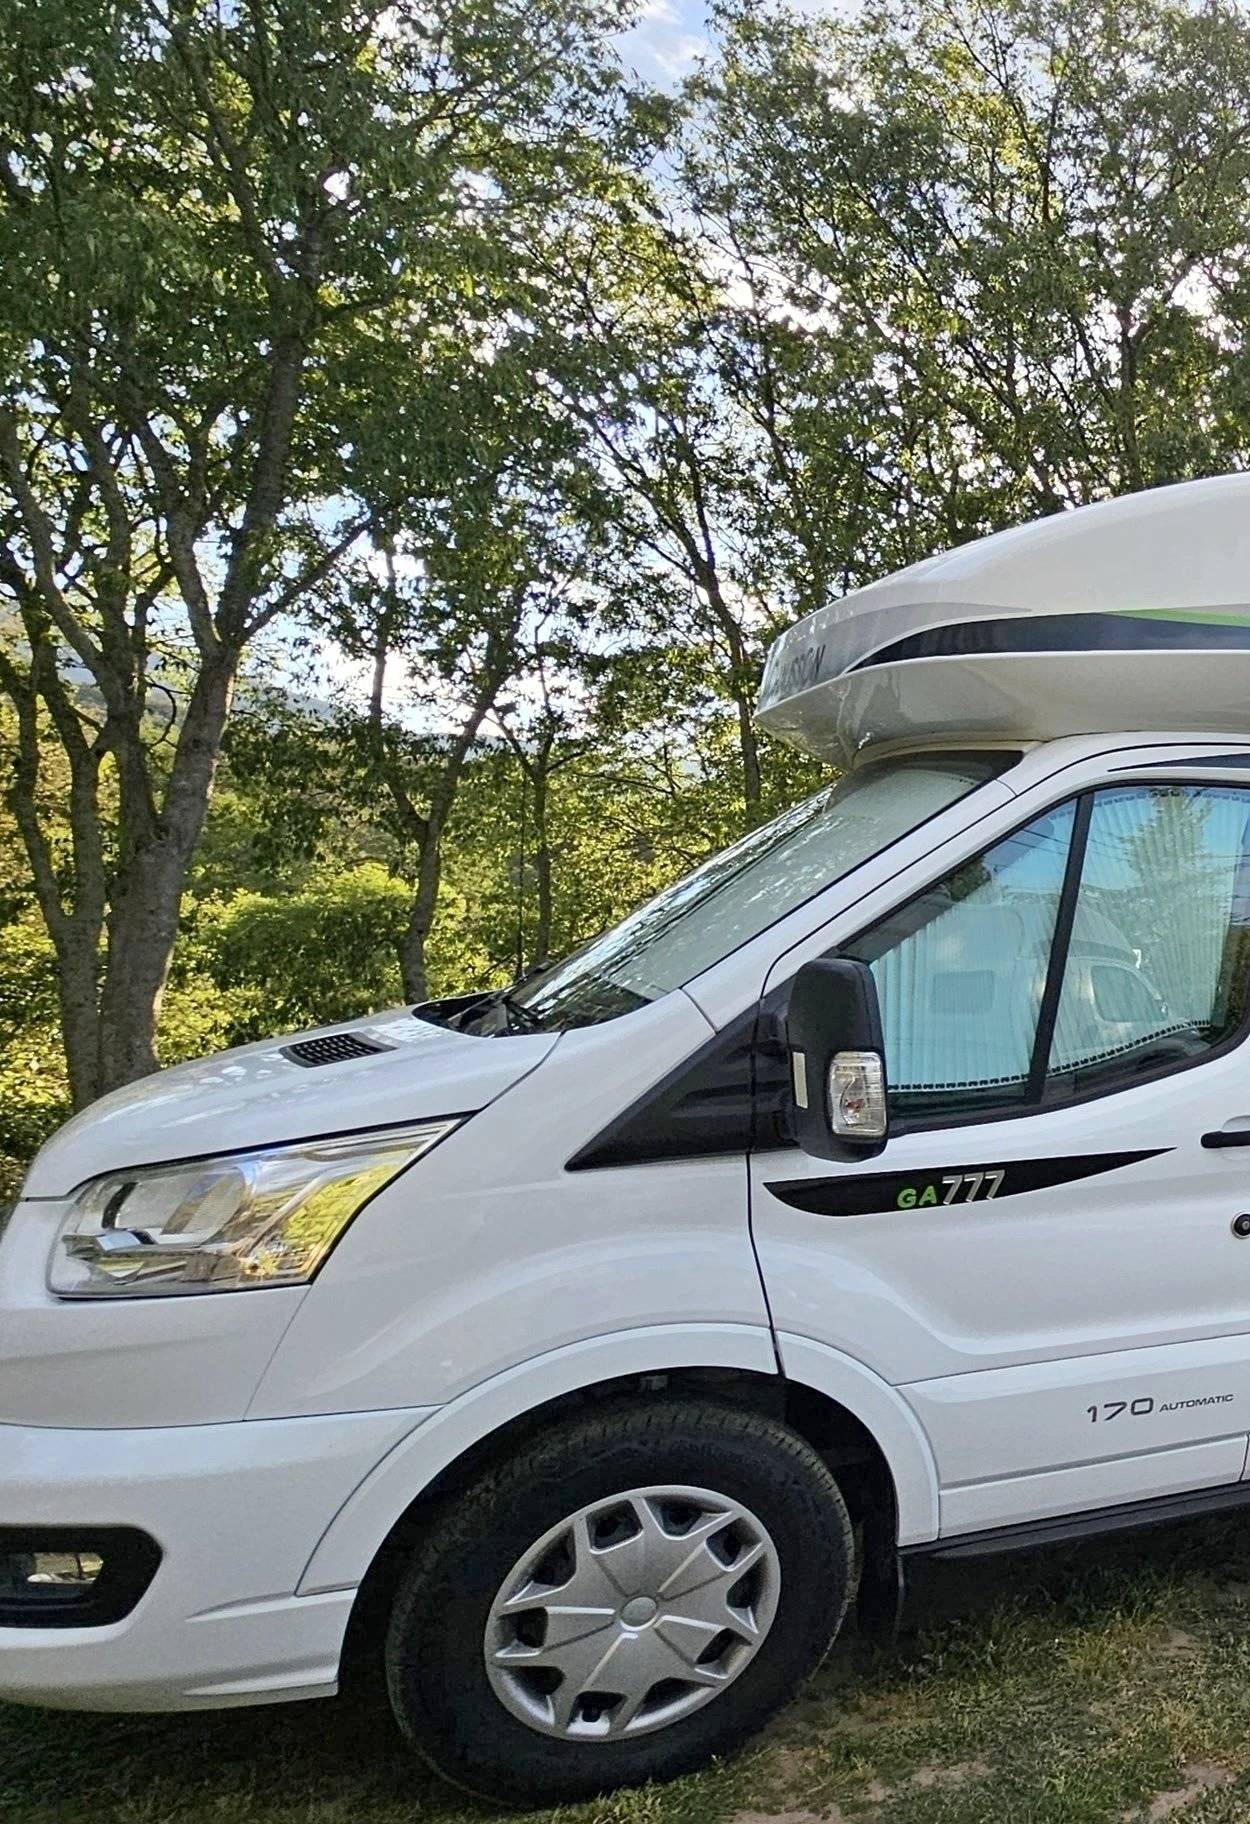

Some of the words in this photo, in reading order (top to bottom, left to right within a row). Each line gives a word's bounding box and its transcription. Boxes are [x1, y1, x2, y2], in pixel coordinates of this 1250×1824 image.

[897, 1170, 1006, 1209] GA777
[1087, 1397, 1154, 1423] 170
[1159, 1394, 1234, 1412] AUTOMATIC
